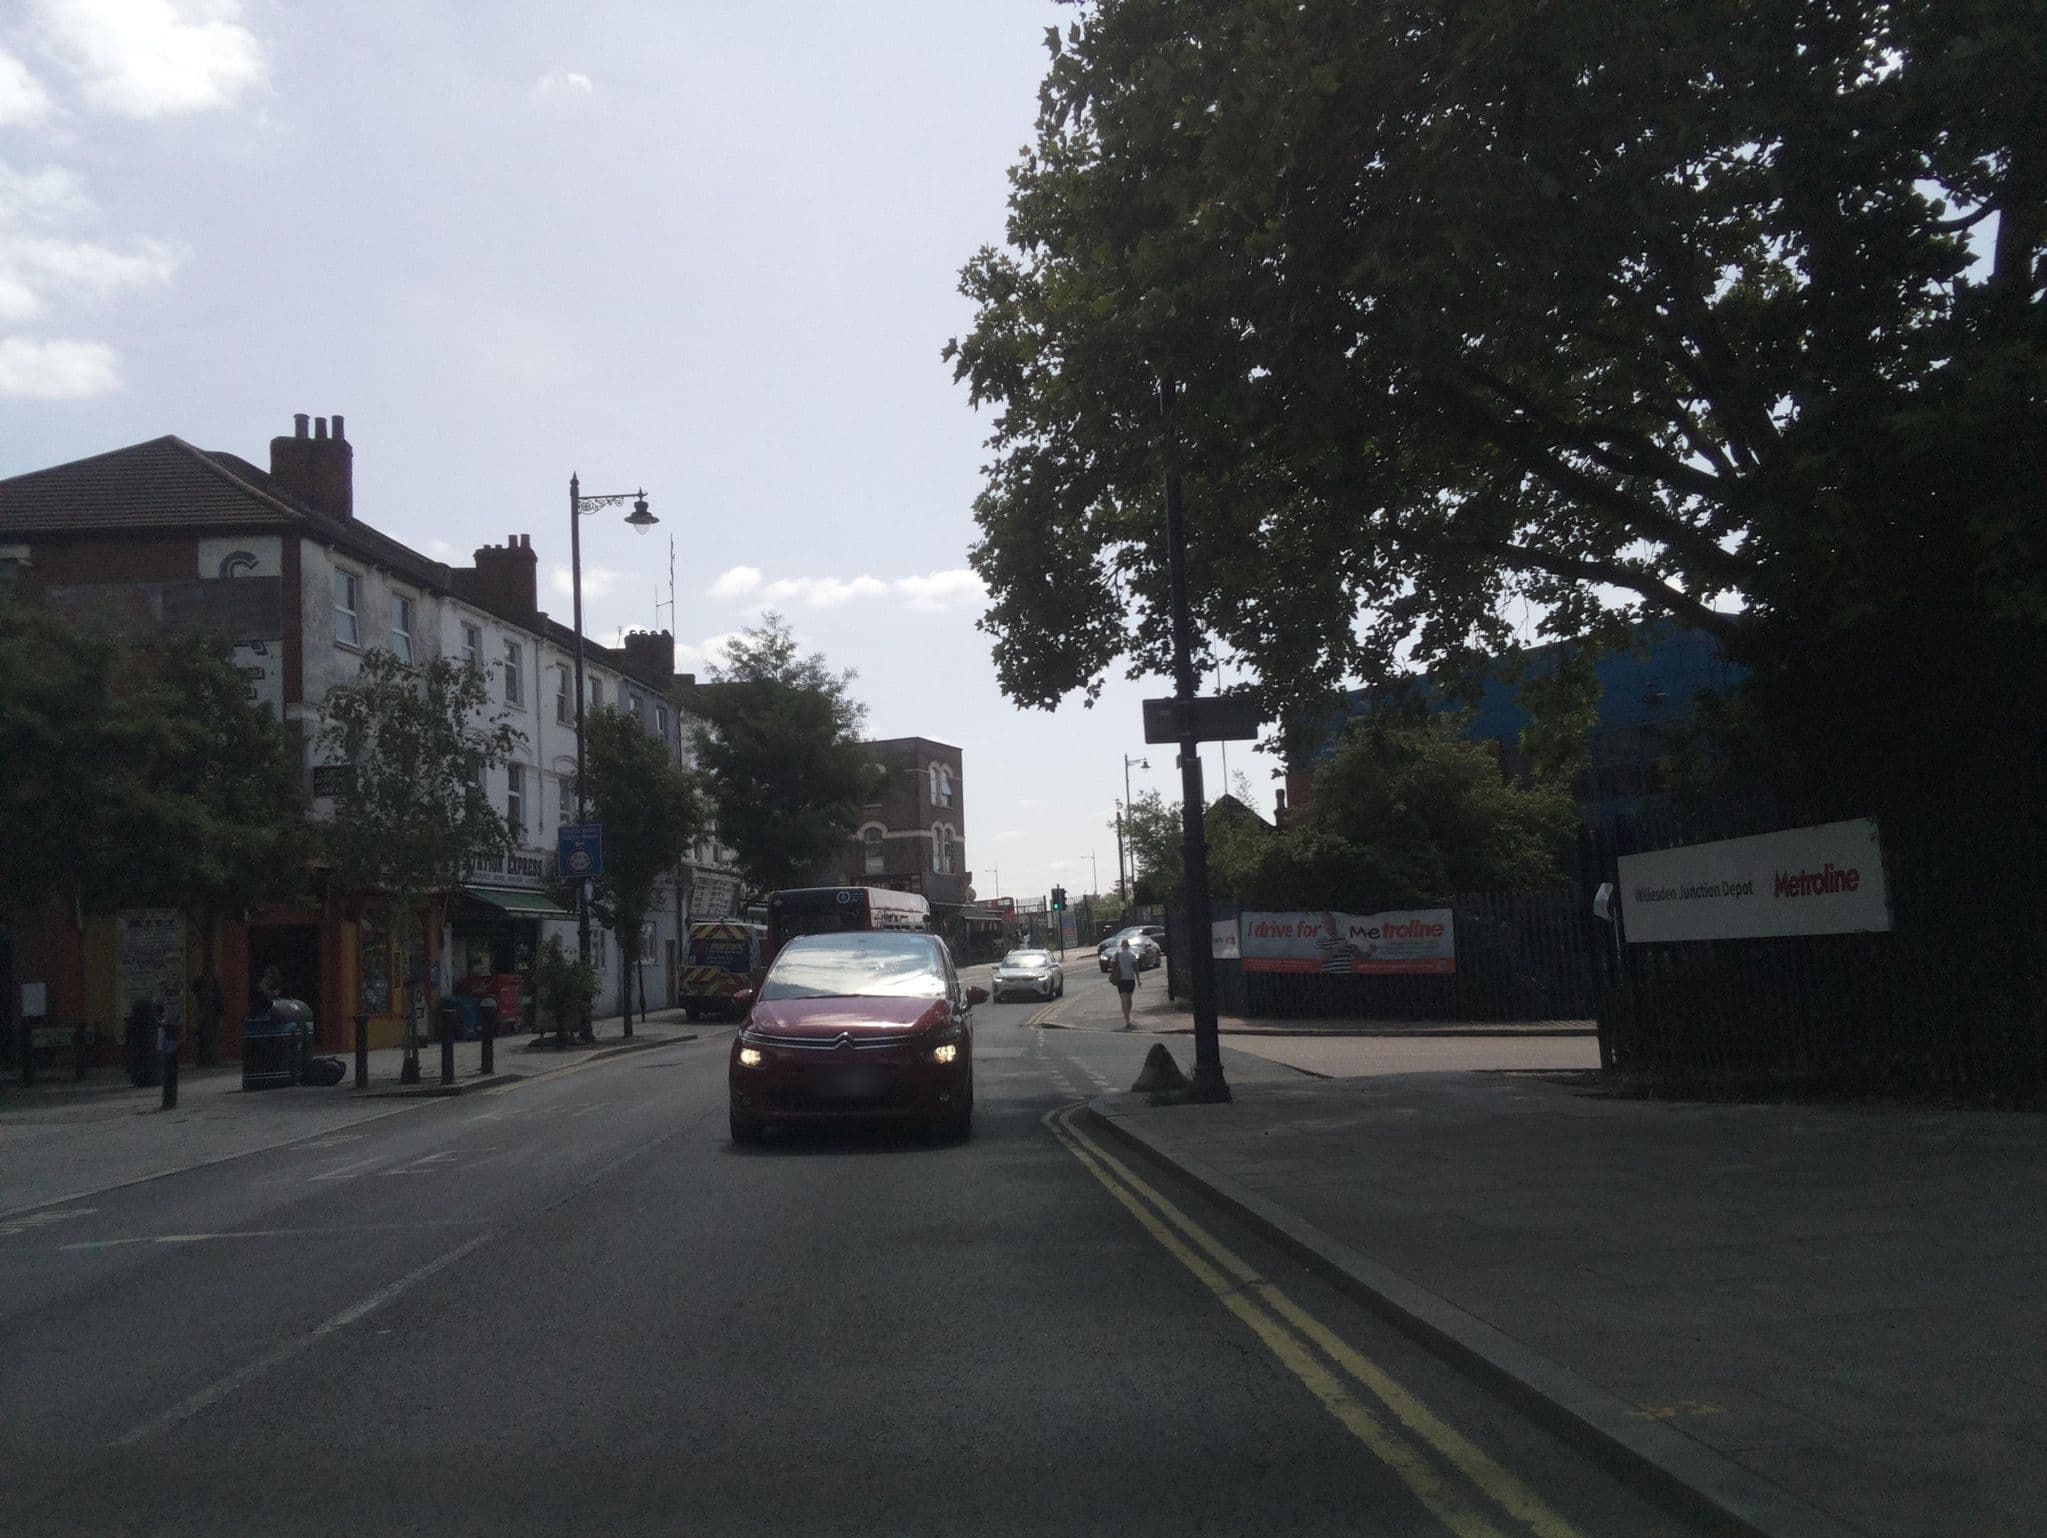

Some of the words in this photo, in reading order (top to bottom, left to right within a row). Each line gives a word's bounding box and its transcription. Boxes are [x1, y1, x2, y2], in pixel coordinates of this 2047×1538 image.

[1678, 883, 1721, 899] Junction
[1722, 879, 1754, 899] Depot
[1774, 863, 1860, 898] Metroline
[1254, 920, 1294, 938] drive
[1296, 921, 1321, 938] for
